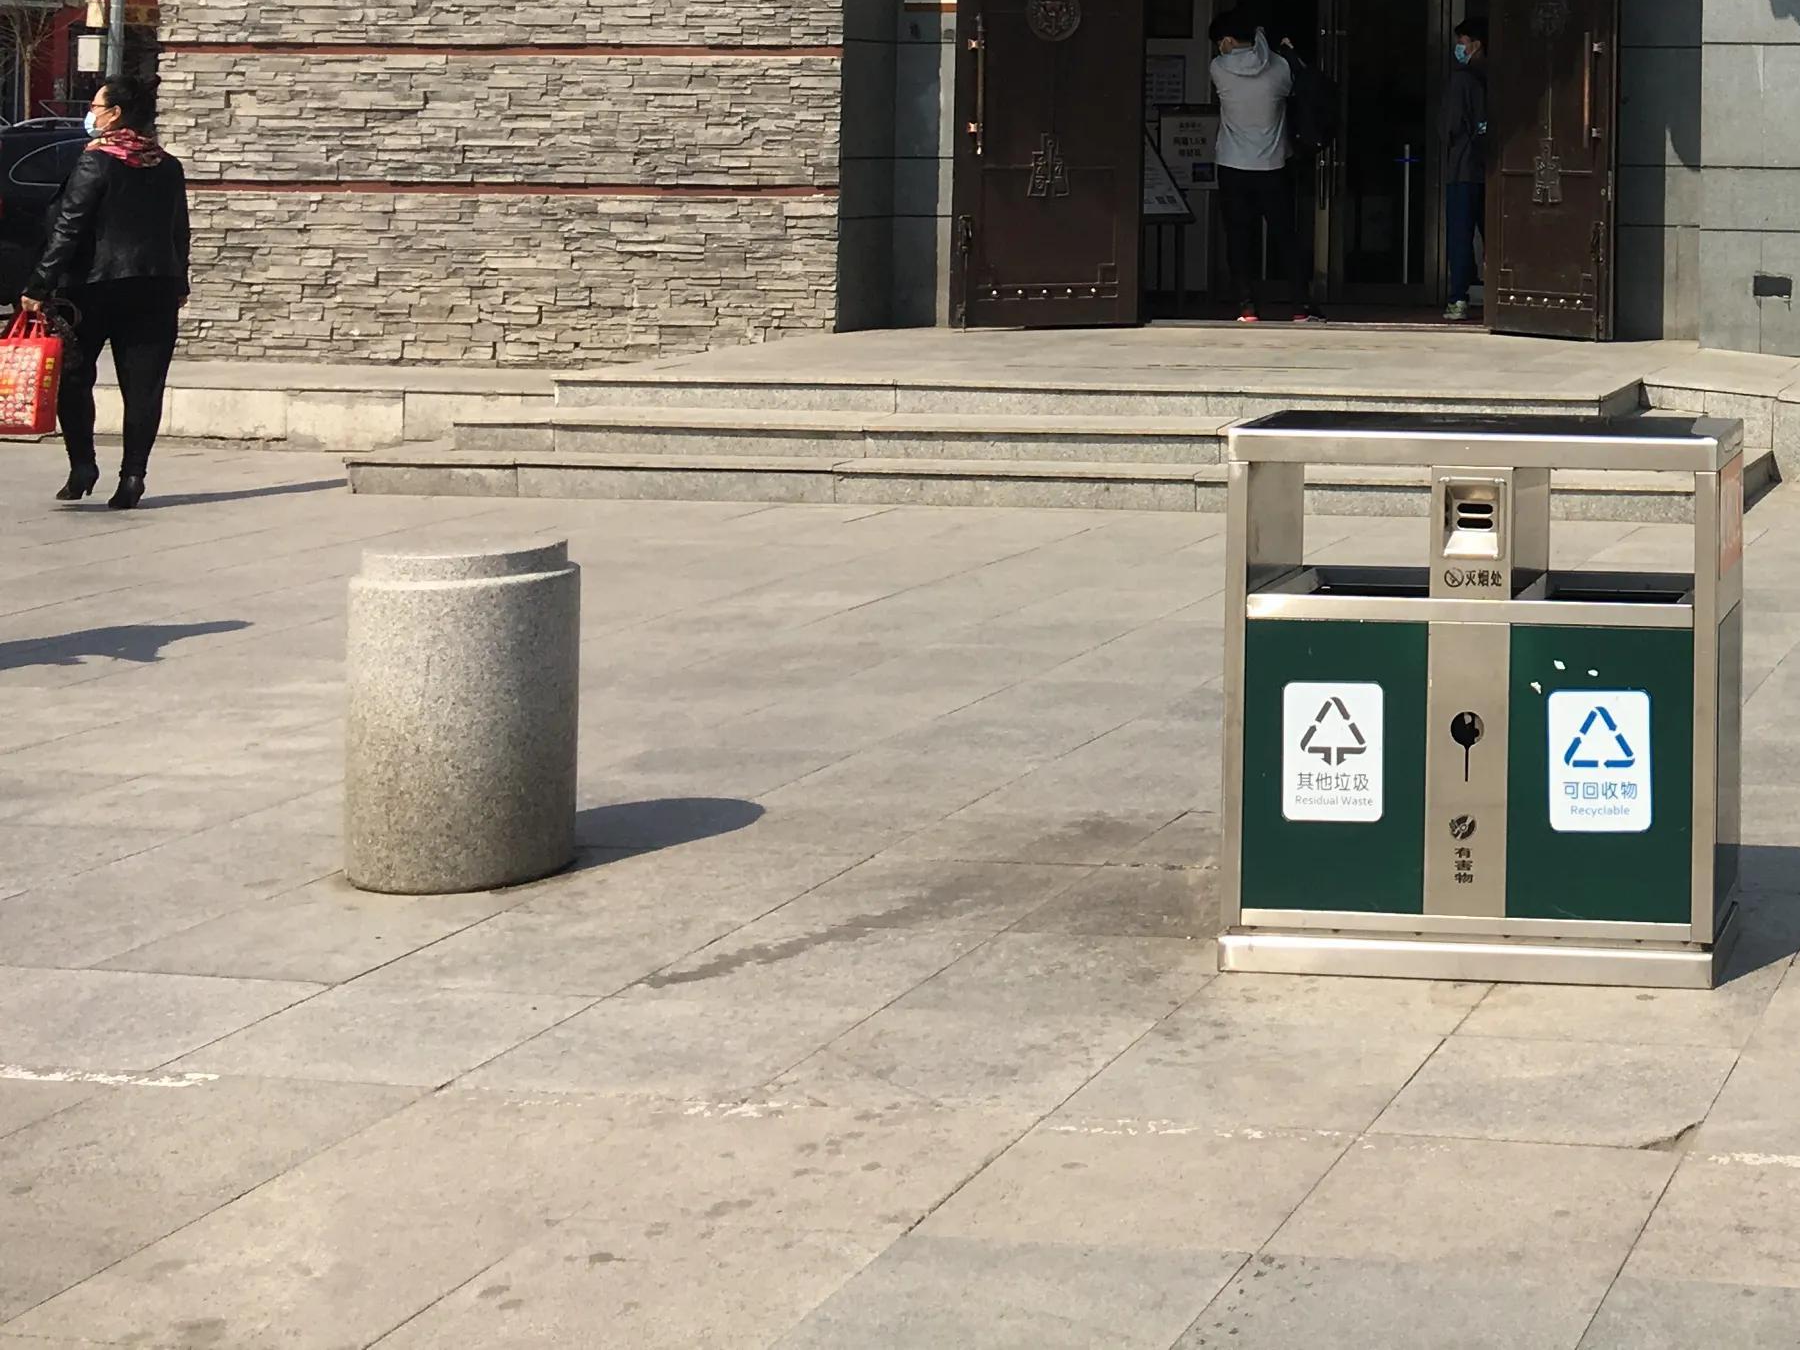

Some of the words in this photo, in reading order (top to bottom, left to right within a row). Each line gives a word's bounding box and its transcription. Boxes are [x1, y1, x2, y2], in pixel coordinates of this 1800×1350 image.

[1465, 569, 1503, 587] 灭烟处
[1297, 771, 1369, 791] 其他垃圾
[1562, 780, 1638, 800] 可回收物
[1295, 795, 1339, 806] Residual
[1341, 796, 1374, 807] Waste
[1570, 805, 1631, 817] Recyclable
[1454, 847, 1474, 884] 有害物
